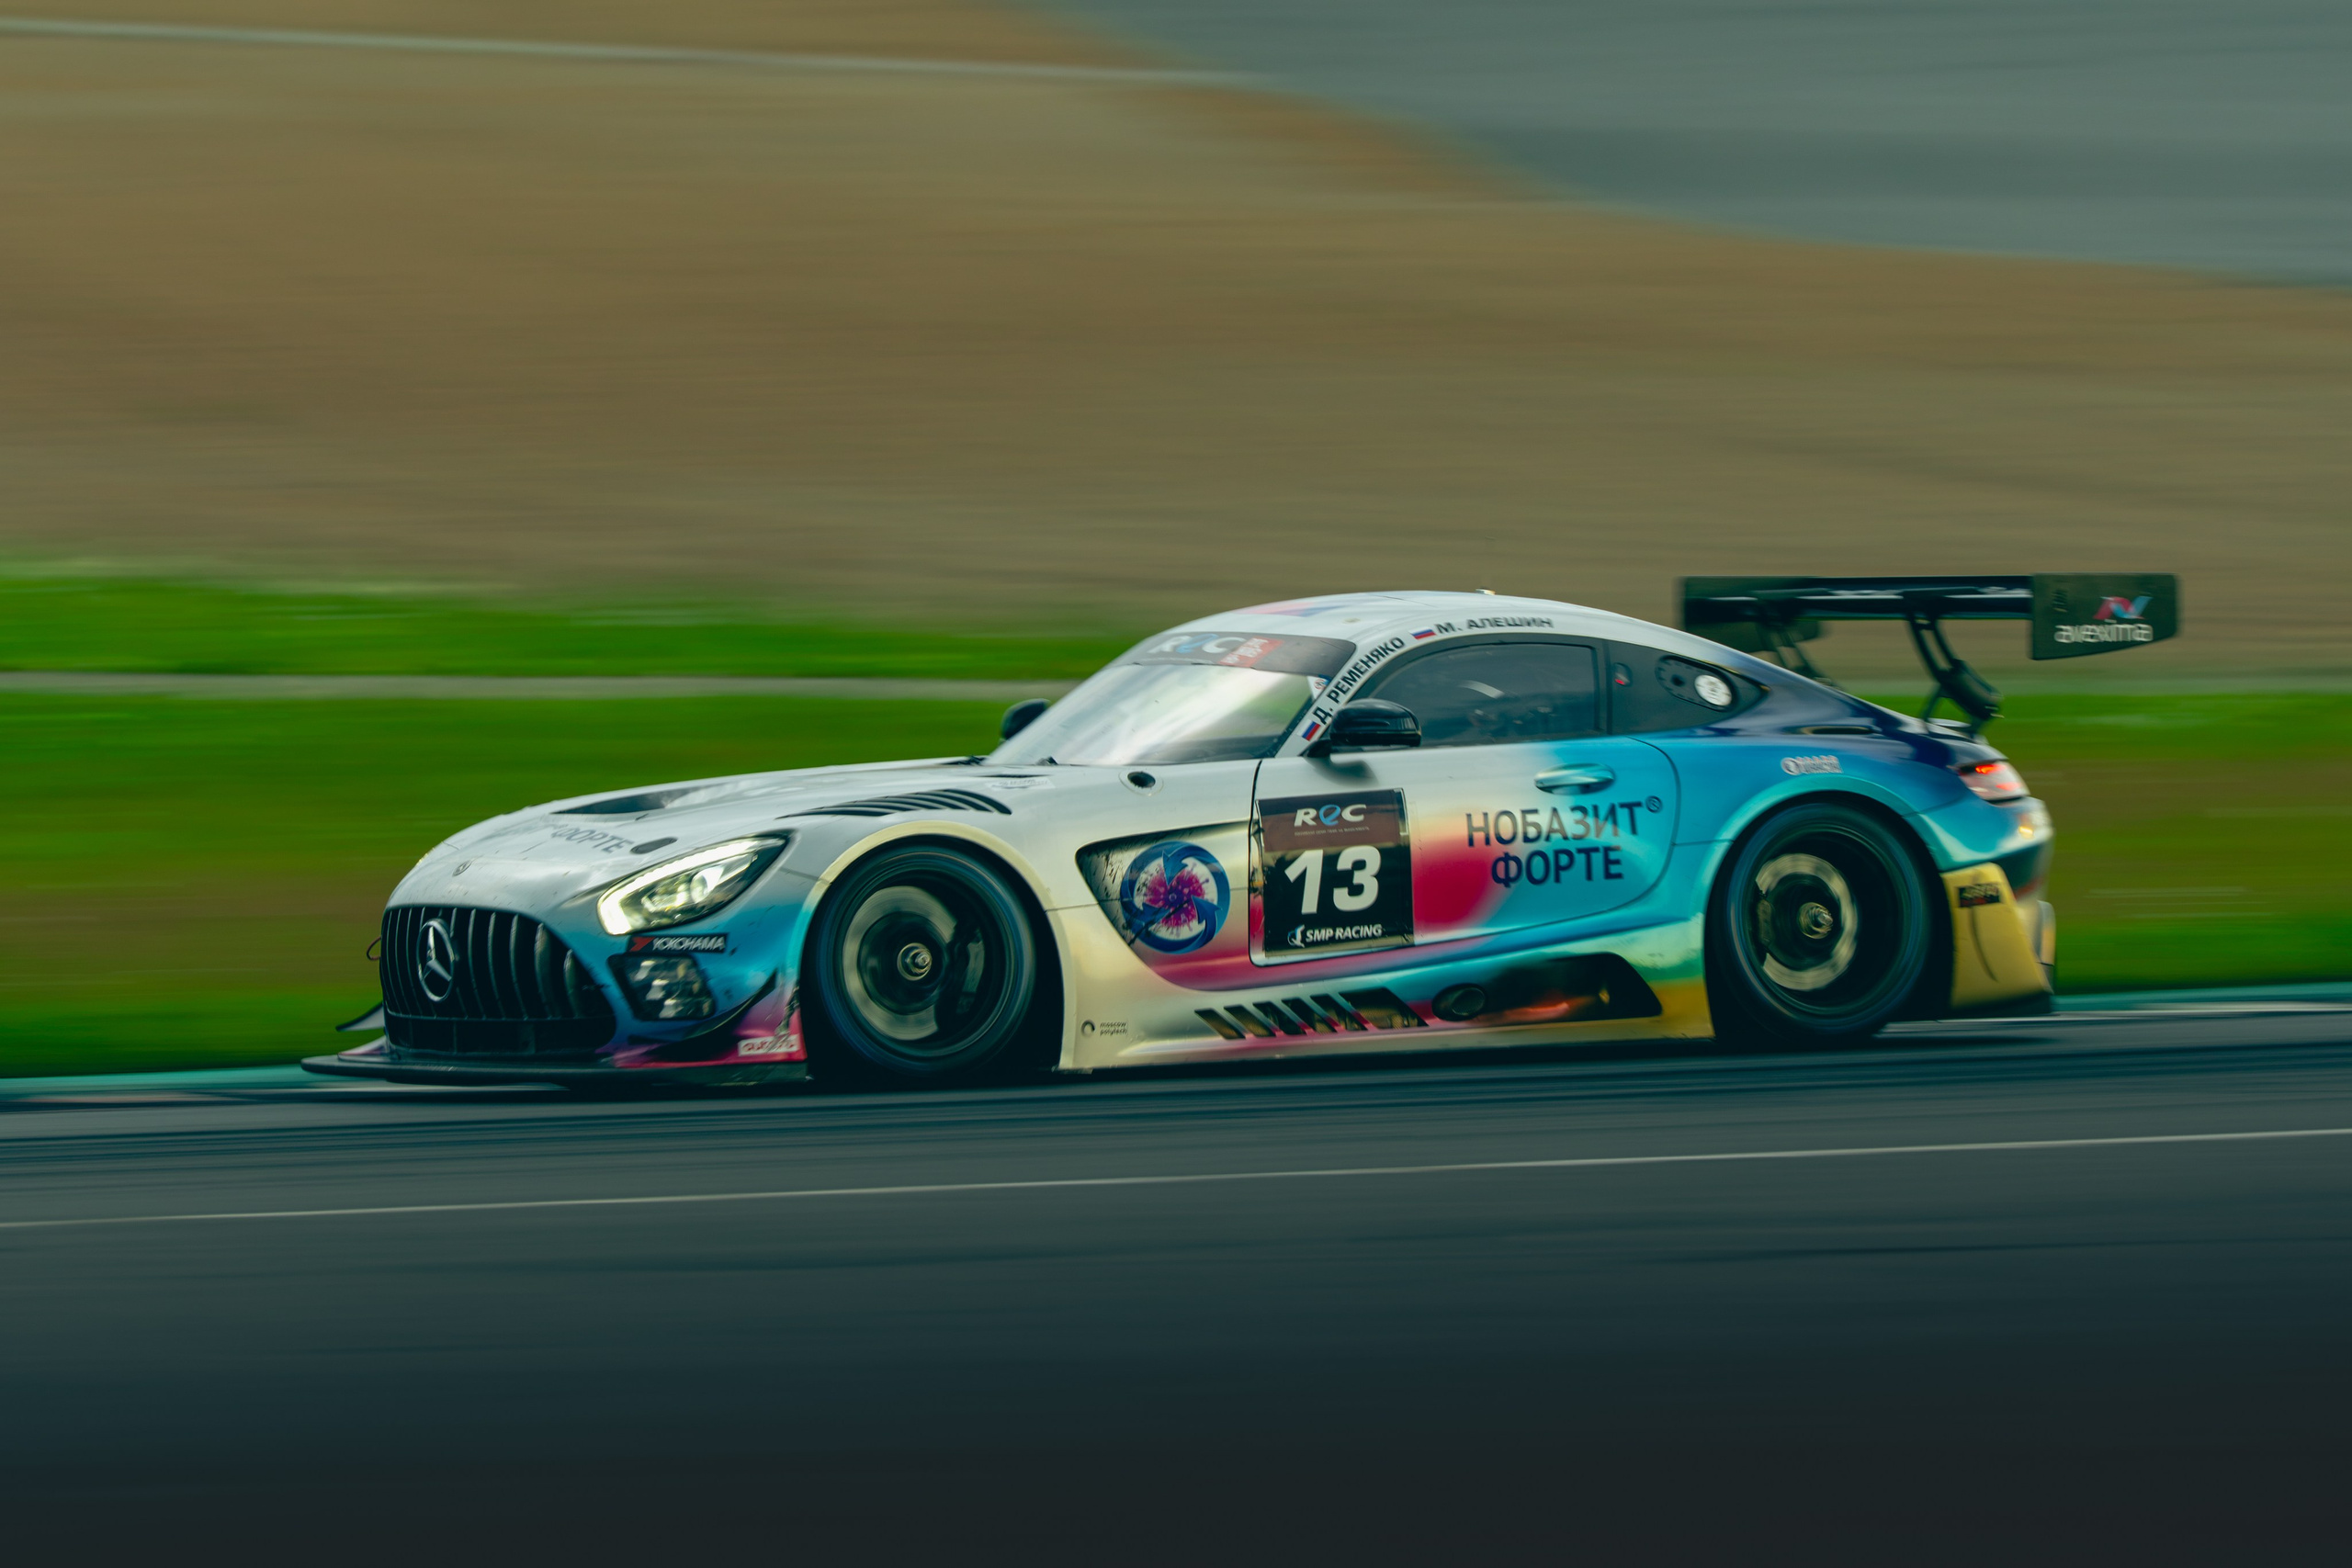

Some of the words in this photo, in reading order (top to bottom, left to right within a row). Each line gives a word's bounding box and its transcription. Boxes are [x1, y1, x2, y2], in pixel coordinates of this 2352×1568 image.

[1434, 623, 1462, 635] М.
[1468, 617, 1555, 630] АЛЕШИН
[1312, 705, 1334, 725] Д.
[1327, 637, 1406, 705] РЕМЕНЯКО
[1283, 844, 1382, 916] 13
[1490, 844, 1624, 889] ФОРТЕ
[652, 936, 726, 951] YOKOHAMA
[1306, 928, 1333, 942] SMP
[1335, 923, 1383, 940] RACING
